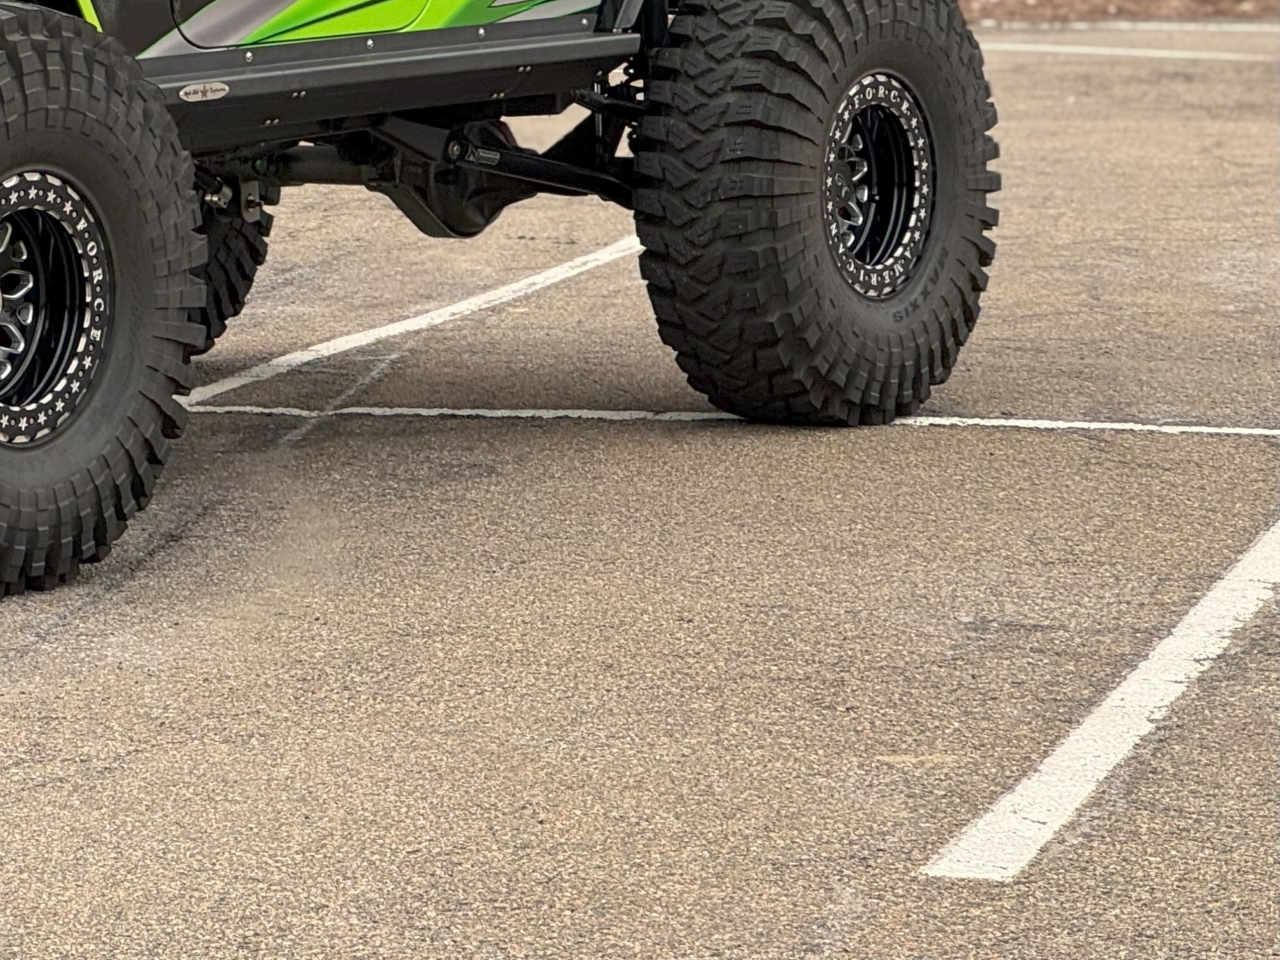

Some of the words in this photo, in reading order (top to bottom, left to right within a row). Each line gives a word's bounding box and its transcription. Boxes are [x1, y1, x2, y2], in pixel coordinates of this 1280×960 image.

[853, 85, 911, 114] FORCE
[76, 217, 105, 341] FORCE
[892, 246, 949, 324] MAXXIS
